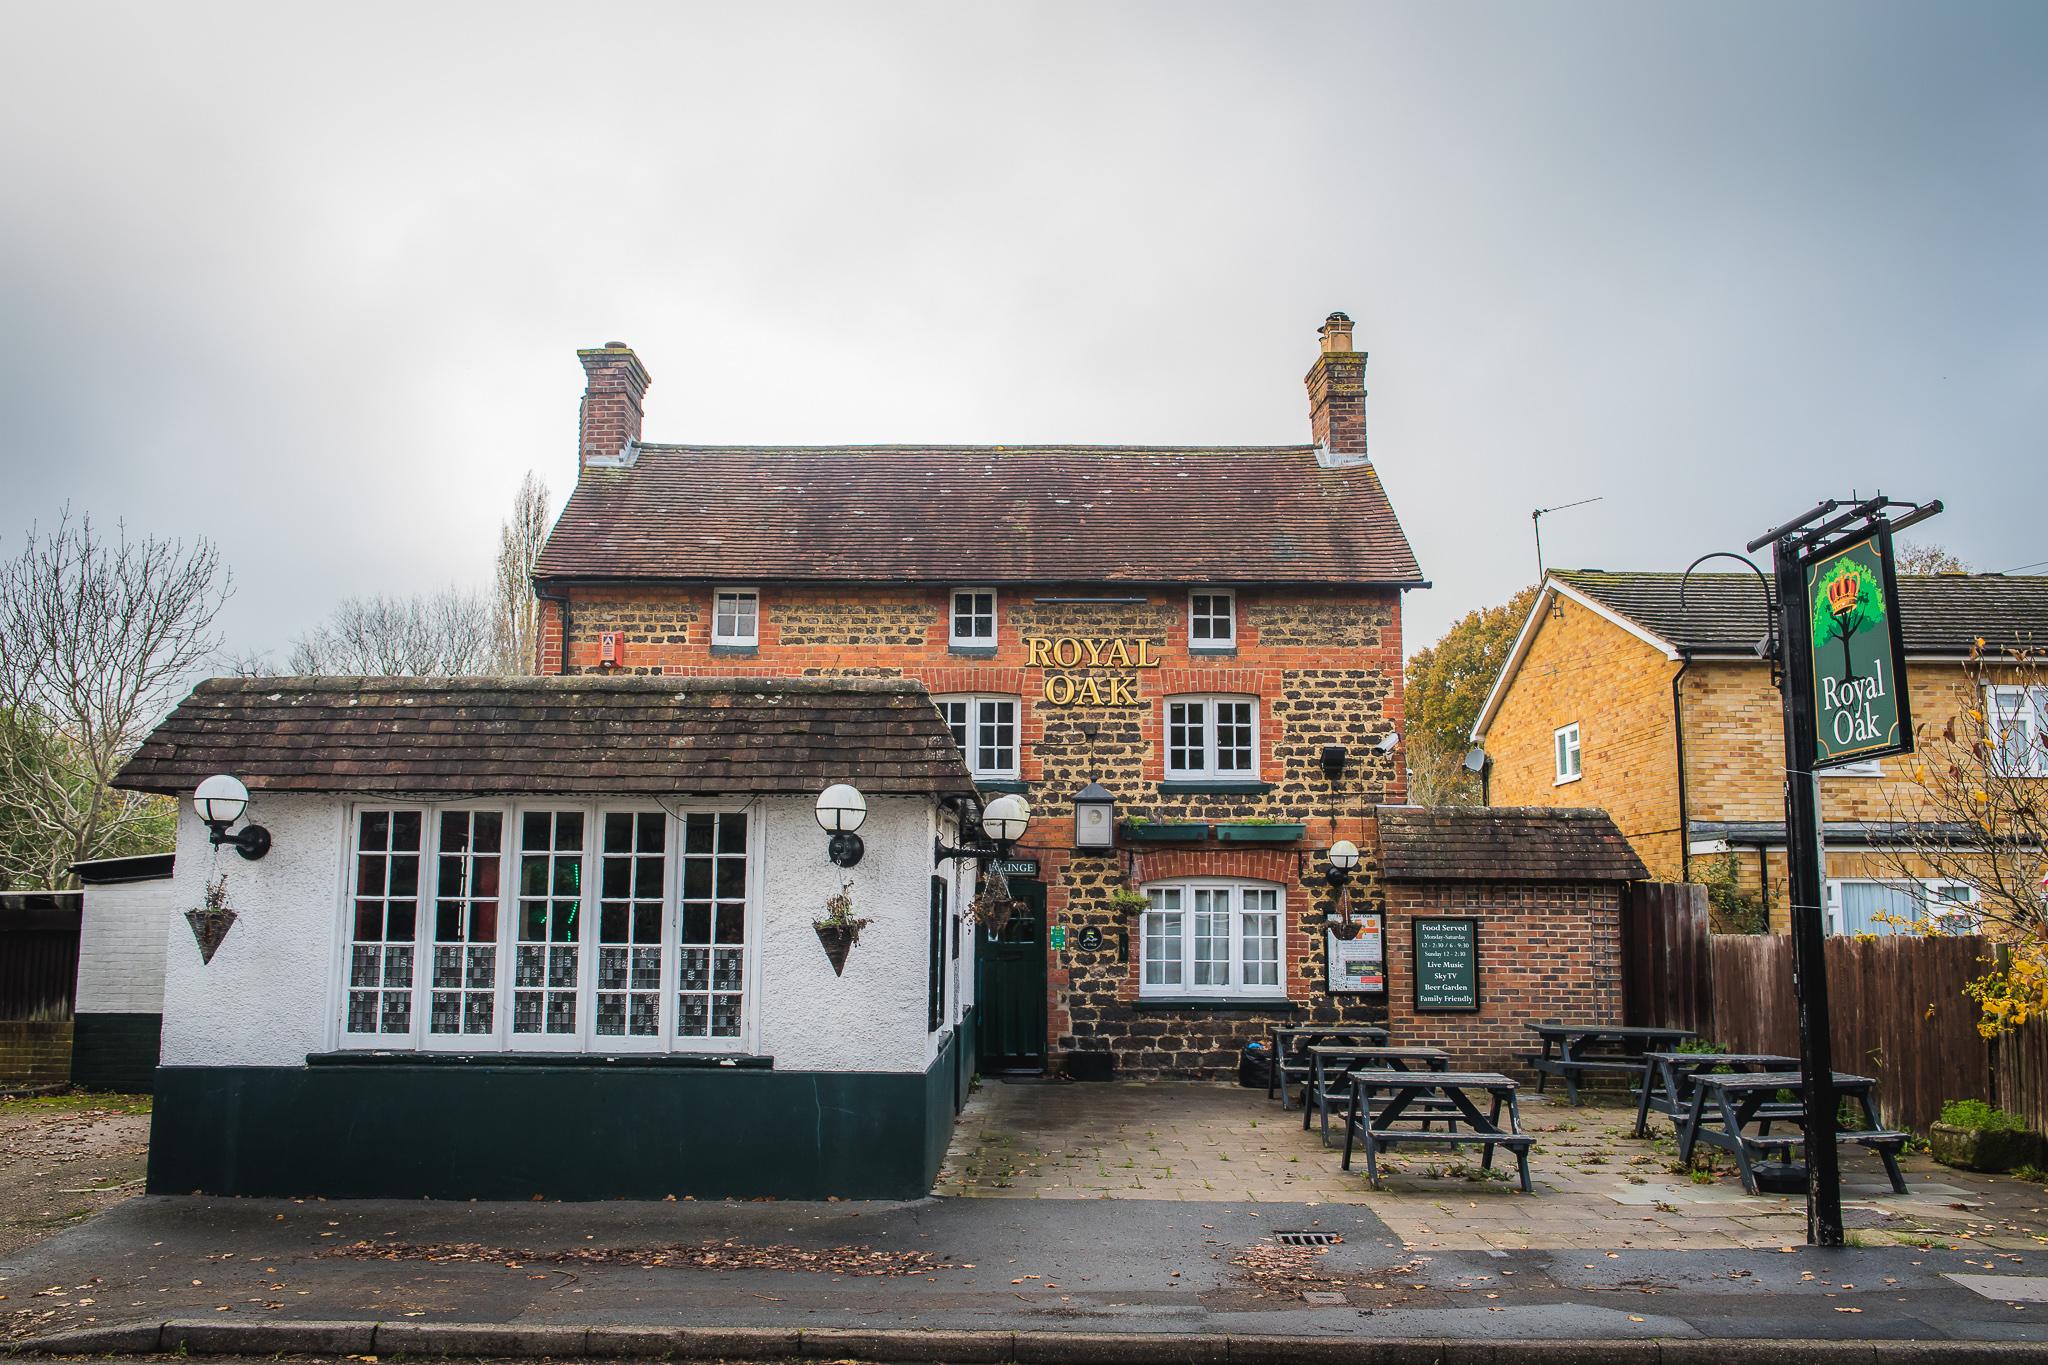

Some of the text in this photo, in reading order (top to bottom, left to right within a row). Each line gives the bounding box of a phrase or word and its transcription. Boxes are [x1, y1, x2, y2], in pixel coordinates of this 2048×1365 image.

[1025, 637, 1161, 668] ROYAL
[1045, 675, 1139, 706] OAK
[1822, 658, 1885, 718] Royal
[1833, 702, 1882, 744] Oak
[1434, 972, 1447, 981] Sky
[1420, 995, 1472, 1004] Family Friendly
